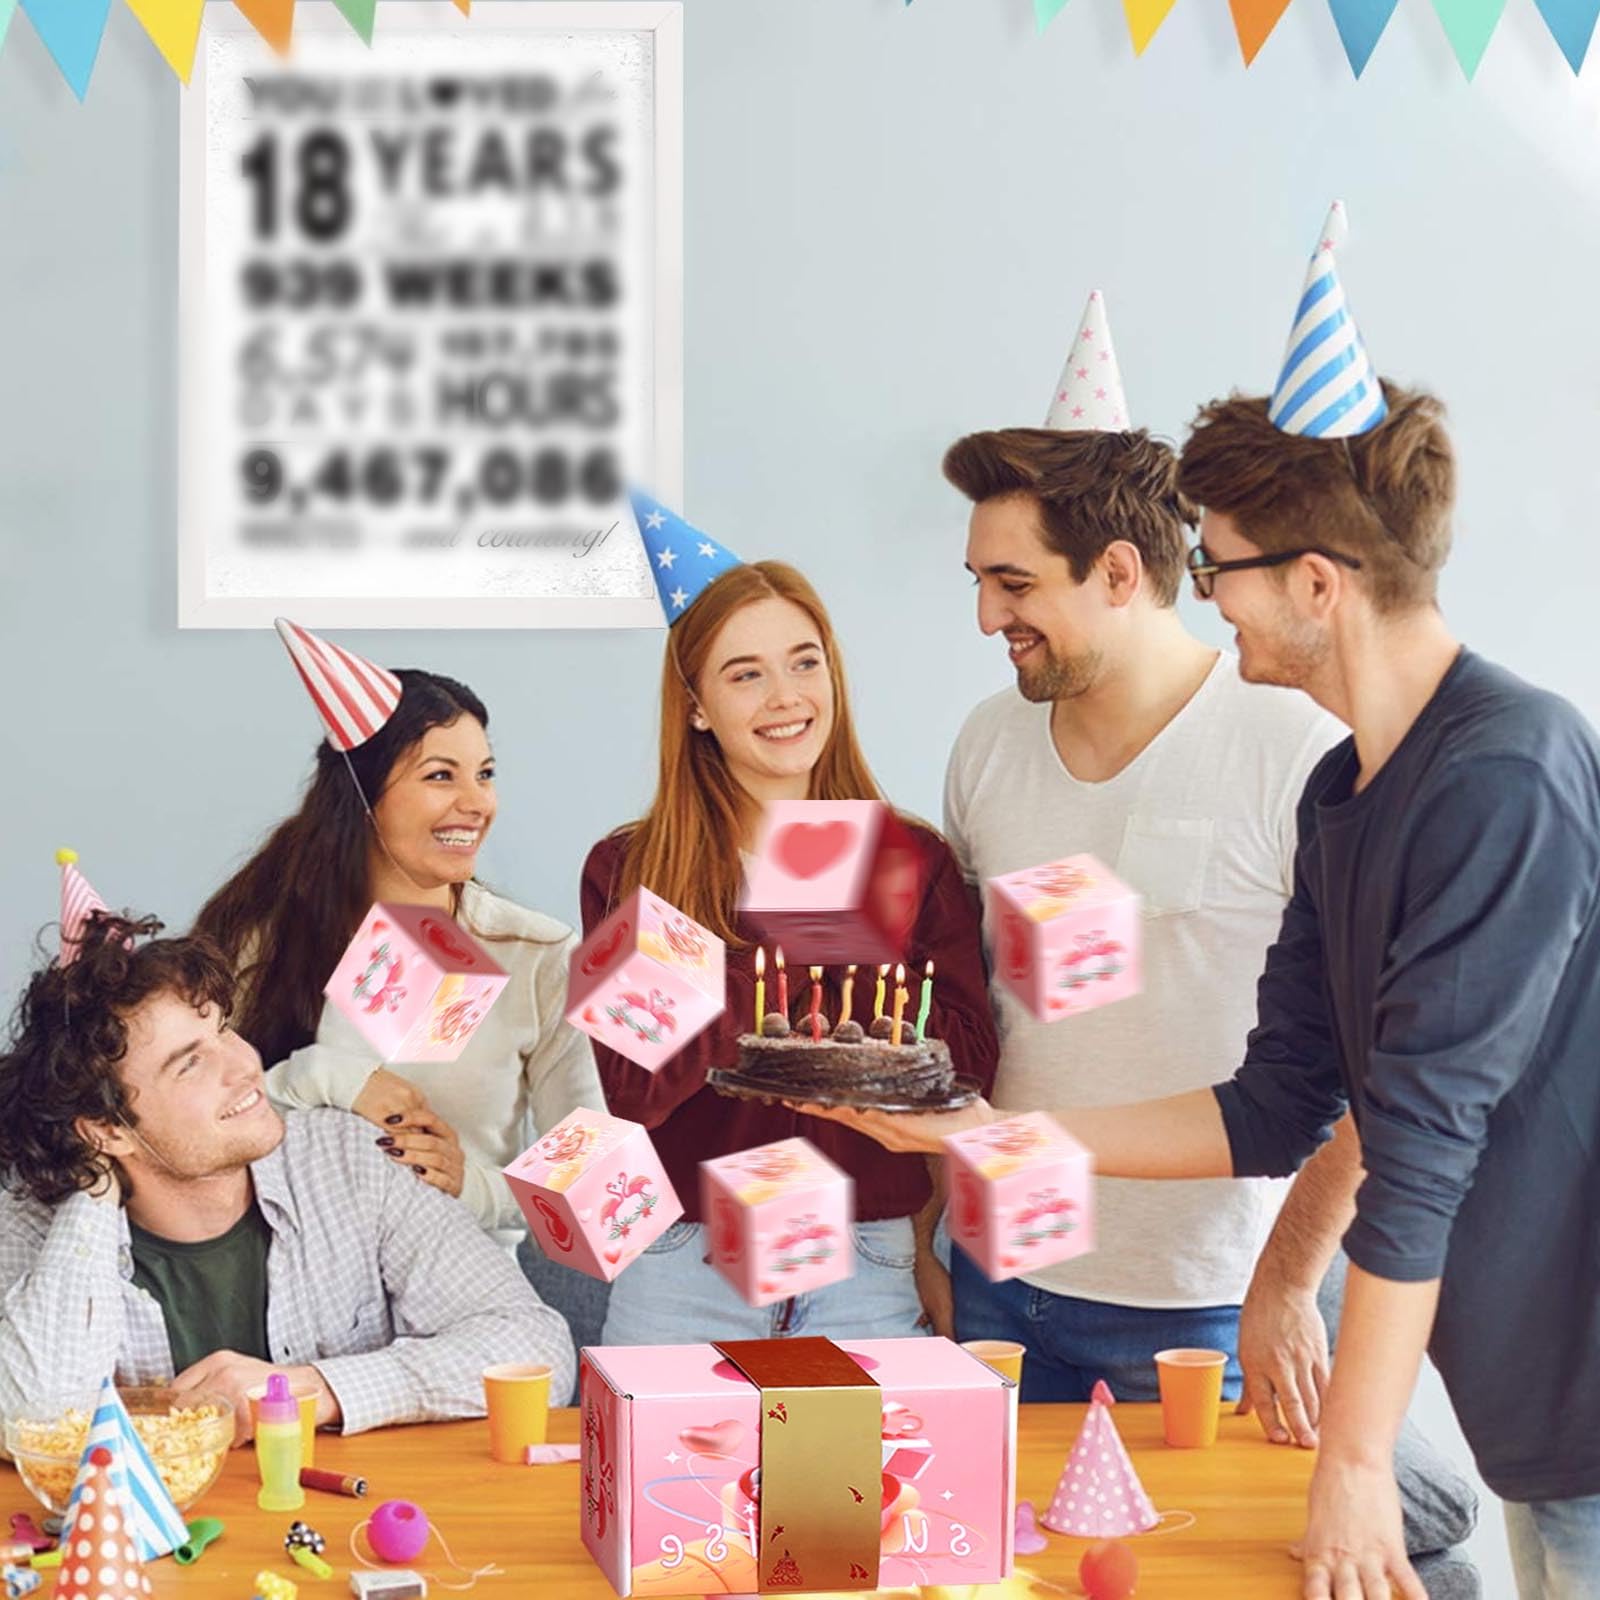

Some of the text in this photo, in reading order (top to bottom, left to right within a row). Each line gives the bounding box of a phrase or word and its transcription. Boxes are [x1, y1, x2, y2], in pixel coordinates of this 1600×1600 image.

[240, 129, 353, 245] 18
[371, 127, 621, 196] YEARS
[383, 259, 619, 308] WEEKS
